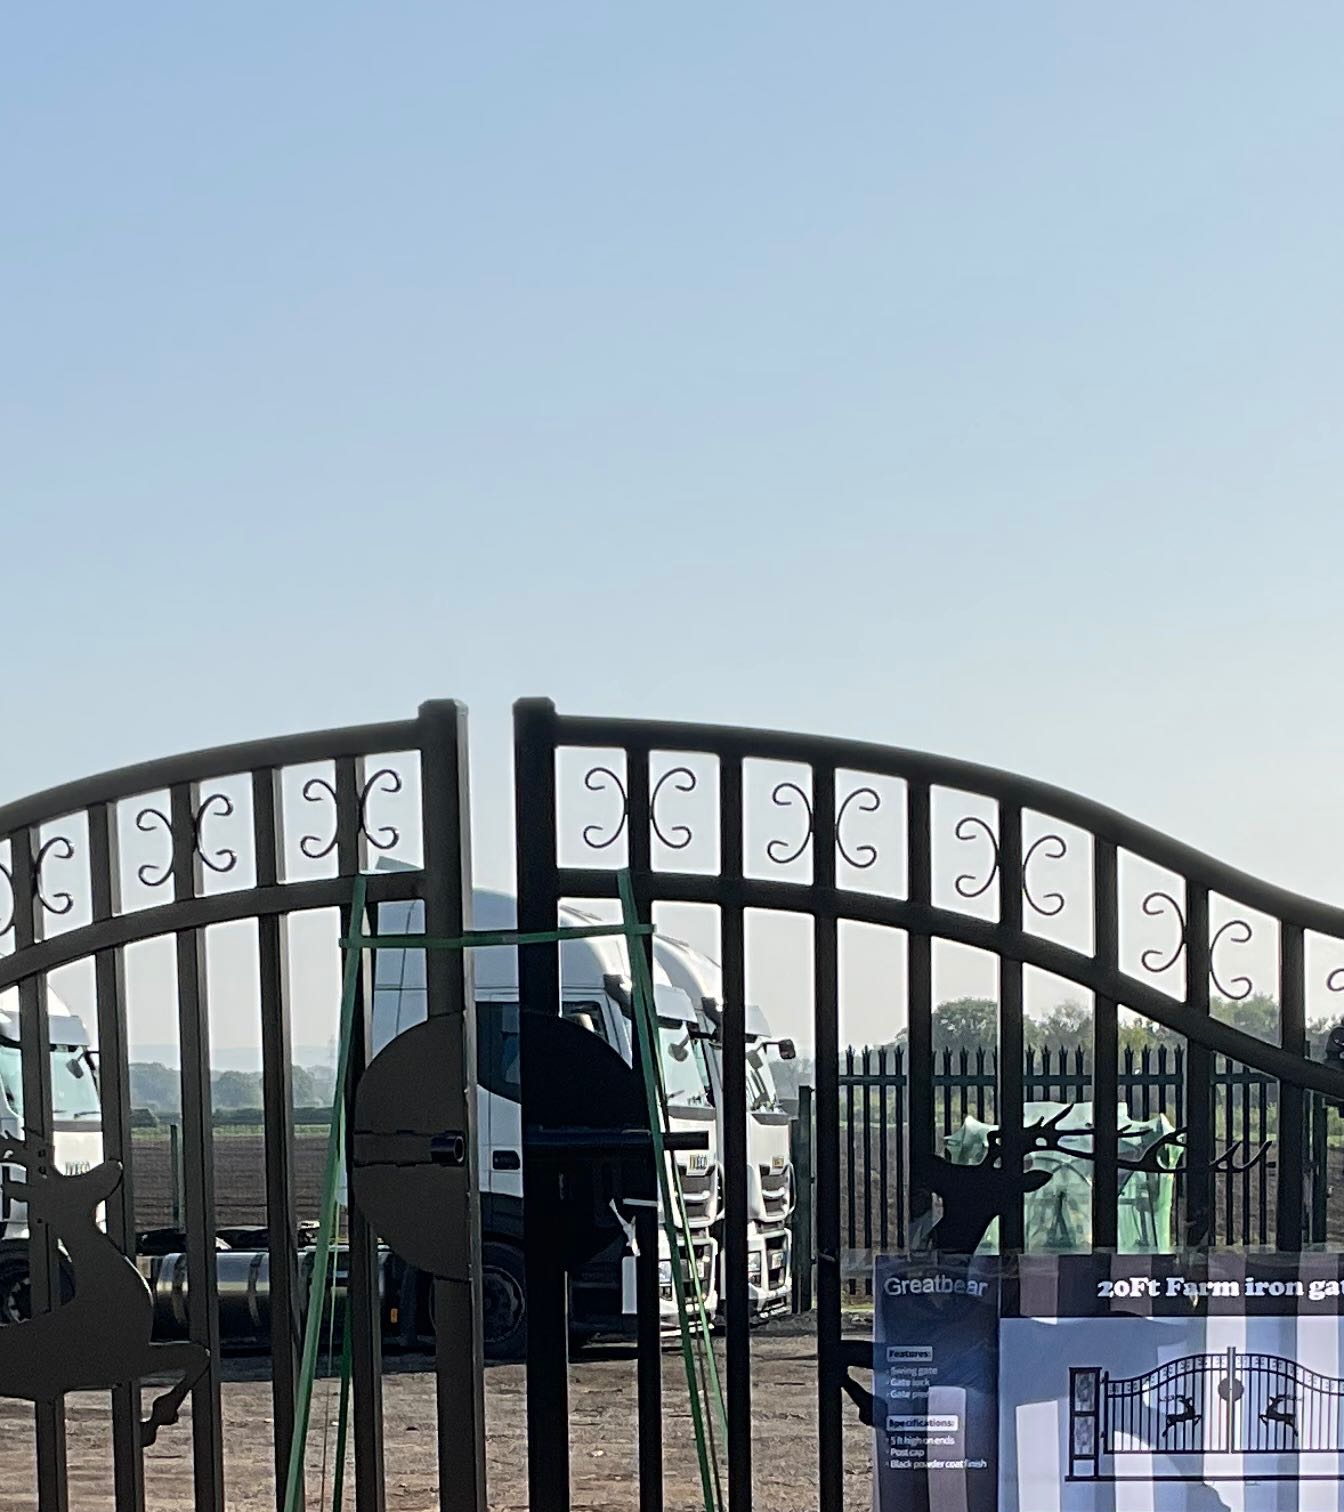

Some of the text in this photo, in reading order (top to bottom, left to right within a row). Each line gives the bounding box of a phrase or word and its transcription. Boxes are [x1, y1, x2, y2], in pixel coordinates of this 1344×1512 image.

[884, 1275, 988, 1296] Greatbear
[1097, 1277, 1160, 1297] 20Ft
[1165, 1277, 1240, 1297] Farm
[1244, 1277, 1304, 1297] iron
[890, 1378, 911, 1387] Gate
[890, 1389, 911, 1398] Gate
[890, 1448, 925, 1458] Post cap
[890, 1459, 912, 1468] Black
[913, 1460, 944, 1470] powder
[945, 1460, 964, 1468] coat
